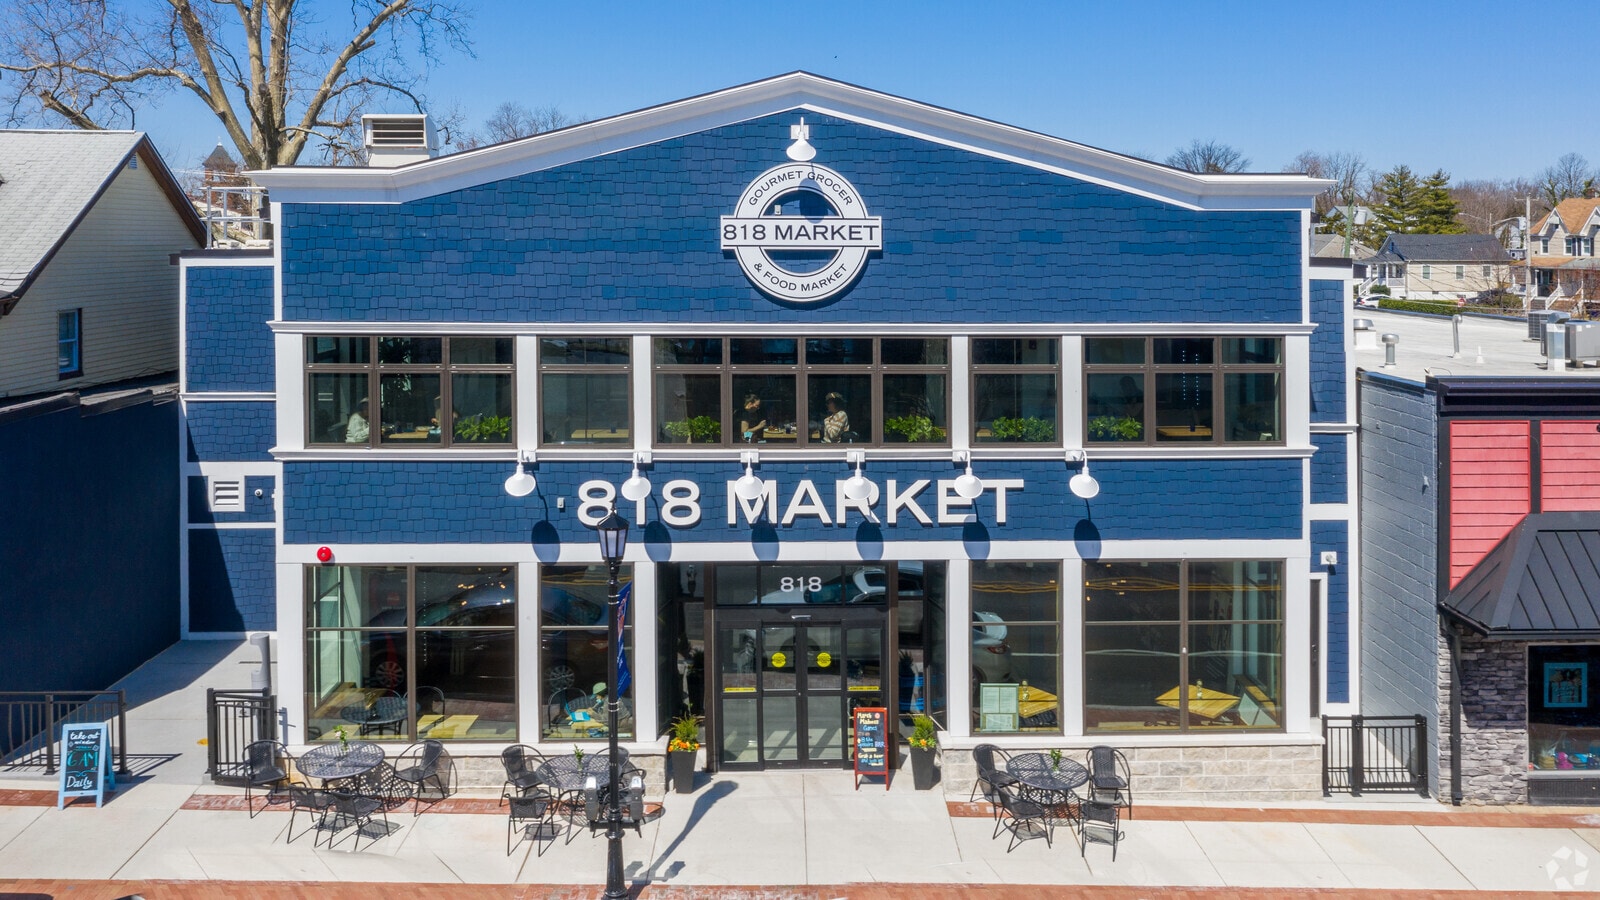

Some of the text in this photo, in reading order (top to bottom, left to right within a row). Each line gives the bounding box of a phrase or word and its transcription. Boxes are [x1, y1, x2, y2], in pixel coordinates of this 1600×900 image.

[749, 170, 853, 206] GOURMET GROCER
[723, 224, 879, 240] 818 MARKET
[753, 262, 848, 292] & FOOD MARKET
[577, 479, 1025, 527] 818 MARKET
[780, 576, 822, 592] 818
[66, 775, 93, 790] Daily
